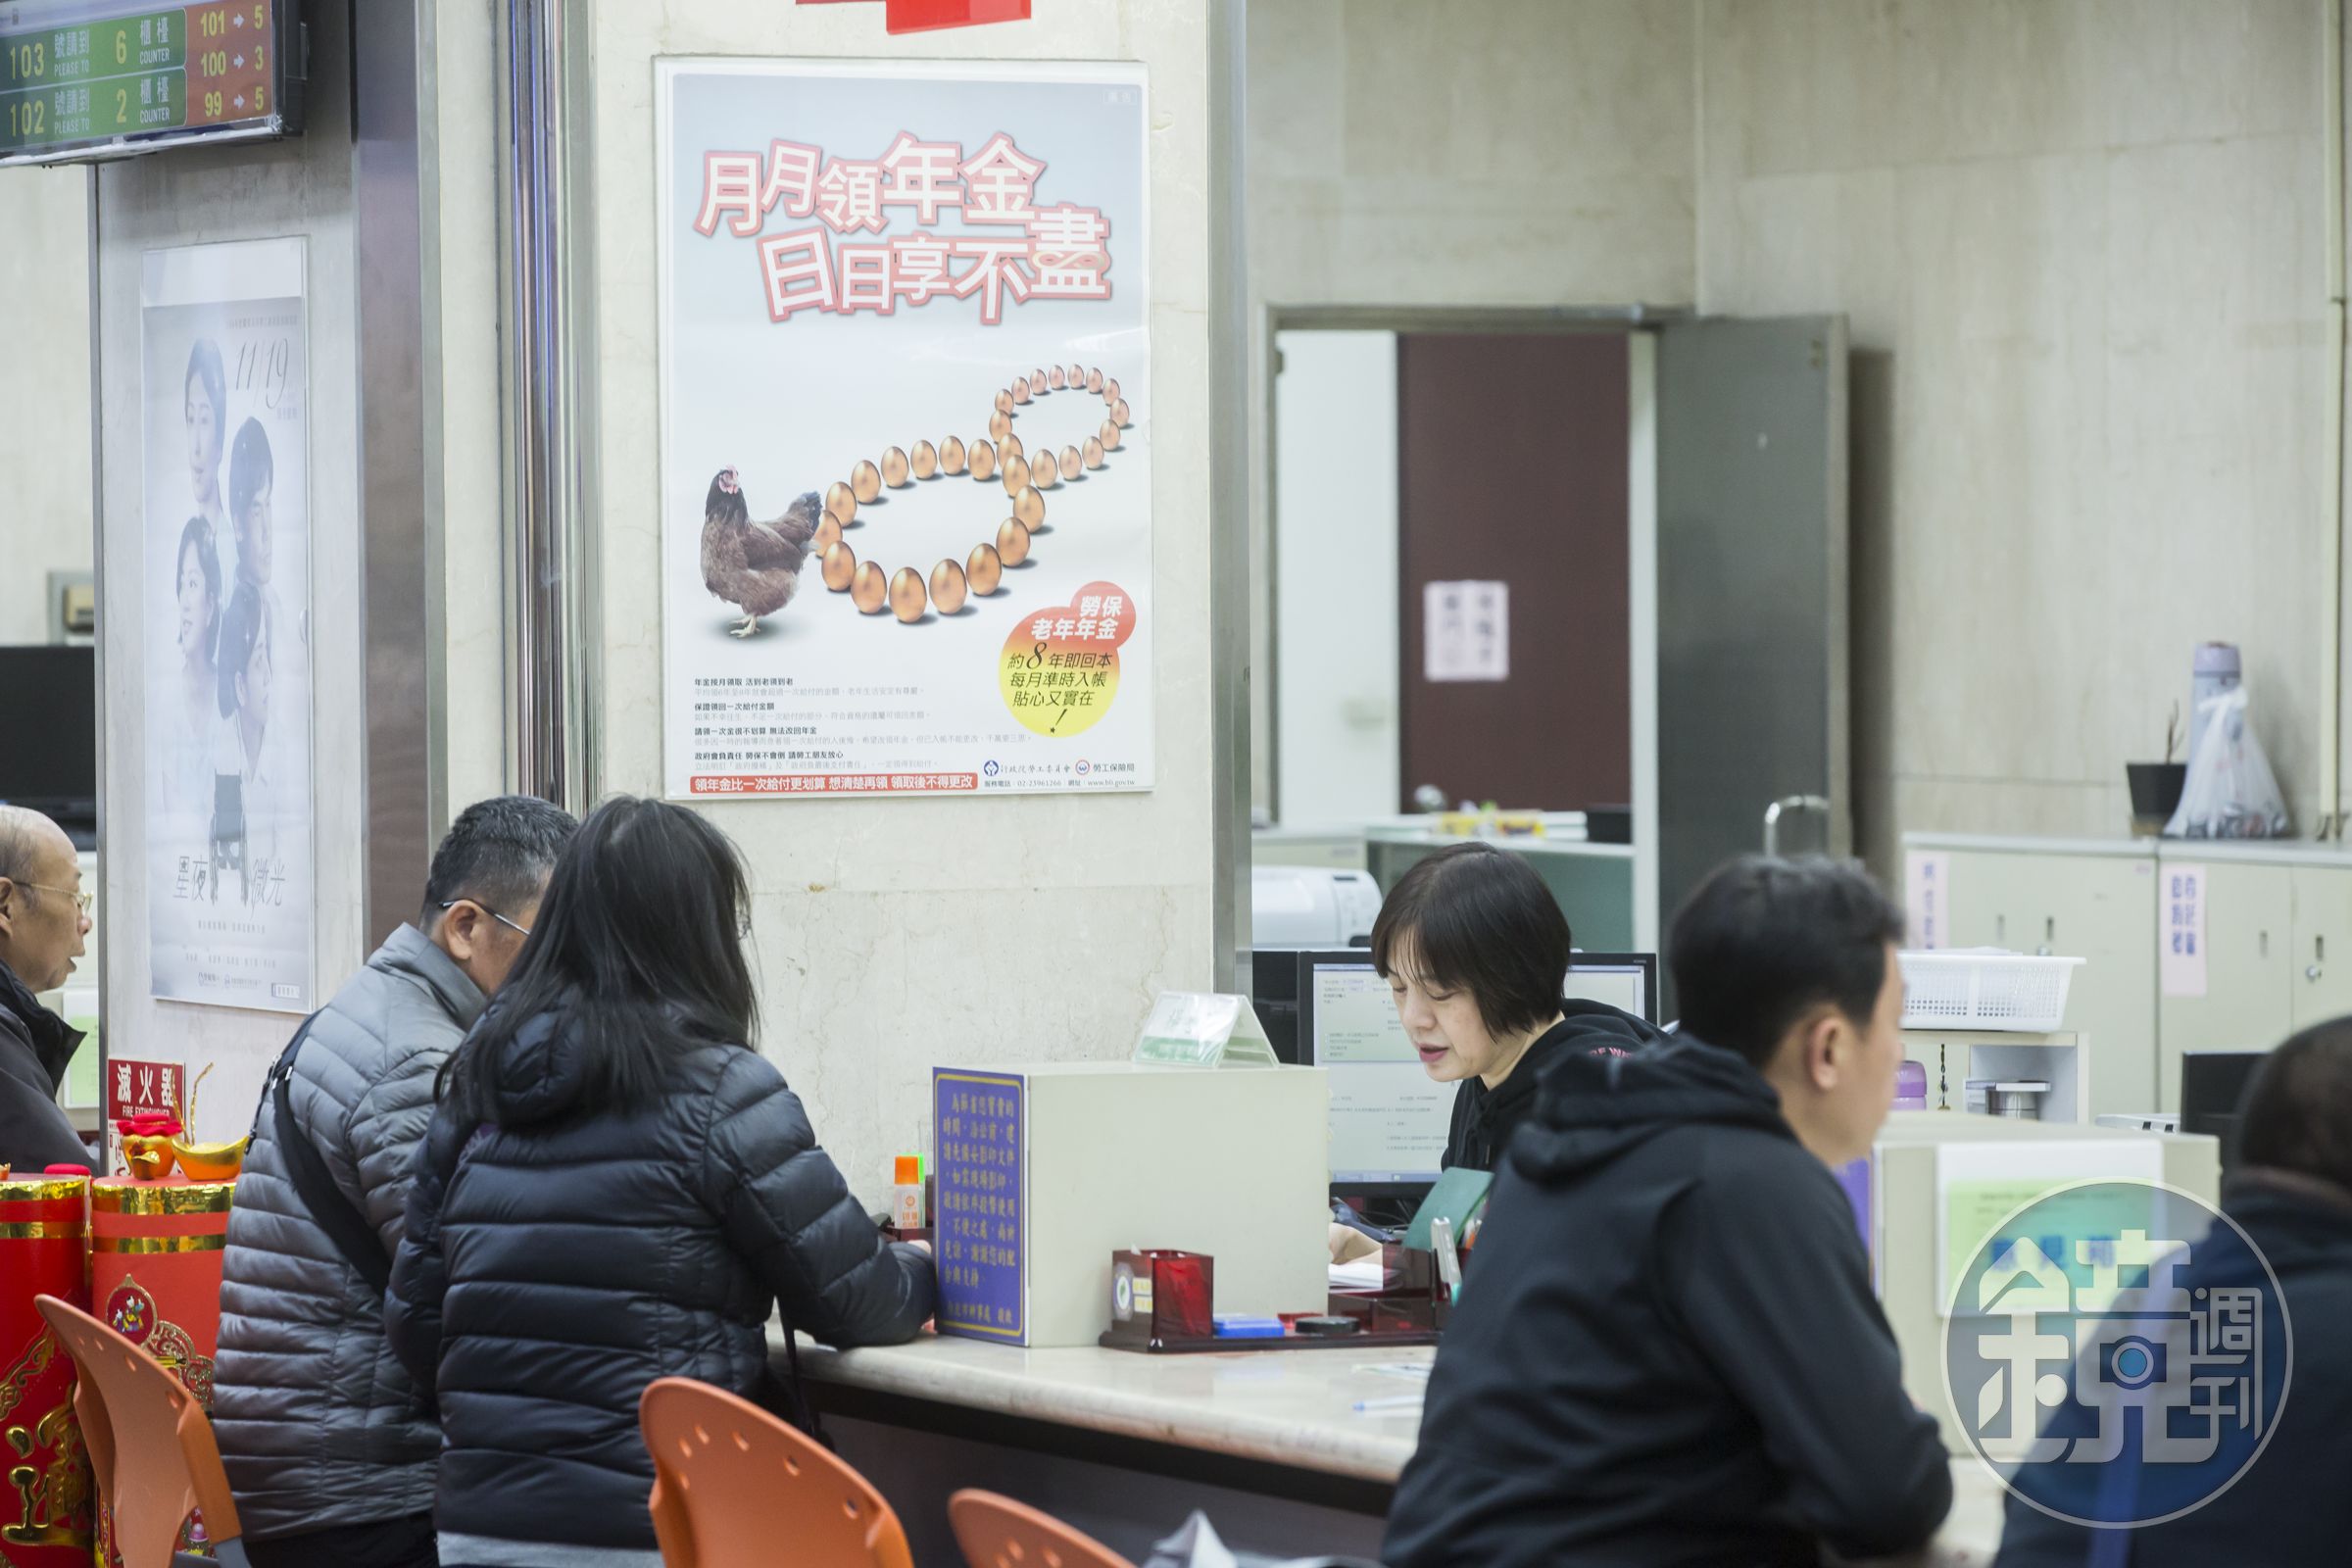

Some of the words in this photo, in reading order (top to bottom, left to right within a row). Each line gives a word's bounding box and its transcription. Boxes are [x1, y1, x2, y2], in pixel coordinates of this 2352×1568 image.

[200, 11, 225, 36] 101
[254, 5, 264, 29] 5
[10, 43, 44, 79] 103
[116, 30, 126, 64] 6
[55, 63, 78, 77] PLEASE
[81, 62, 89, 73] TO
[139, 48, 170, 64] COUNTER
[200, 52, 226, 77] 100
[255, 46, 264, 71] 3
[10, 100, 44, 137] 102
[117, 88, 126, 123] 2
[205, 91, 222, 117] 99
[255, 86, 264, 111] 5
[55, 121, 78, 134] PLEASE
[81, 120, 89, 131] TO
[140, 107, 170, 124] COUNTER
[697, 133, 1043, 235] 月月領年金
[760, 207, 1108, 322] 日日享不盡
[1079, 596, 1122, 617] 勞保
[1031, 618, 1119, 640] 老年年金
[1009, 671, 1107, 687] 每月準時入帳
[1012, 690, 1094, 707] 貼心又實在
[695, 776, 825, 793] 領年金比一次給付更划算
[829, 775, 888, 791] 想清楚再領
[891, 774, 973, 790] 領取後不得更改
[118, 1063, 174, 1106] 滅火器
[122, 1105, 133, 1117] FIRE
